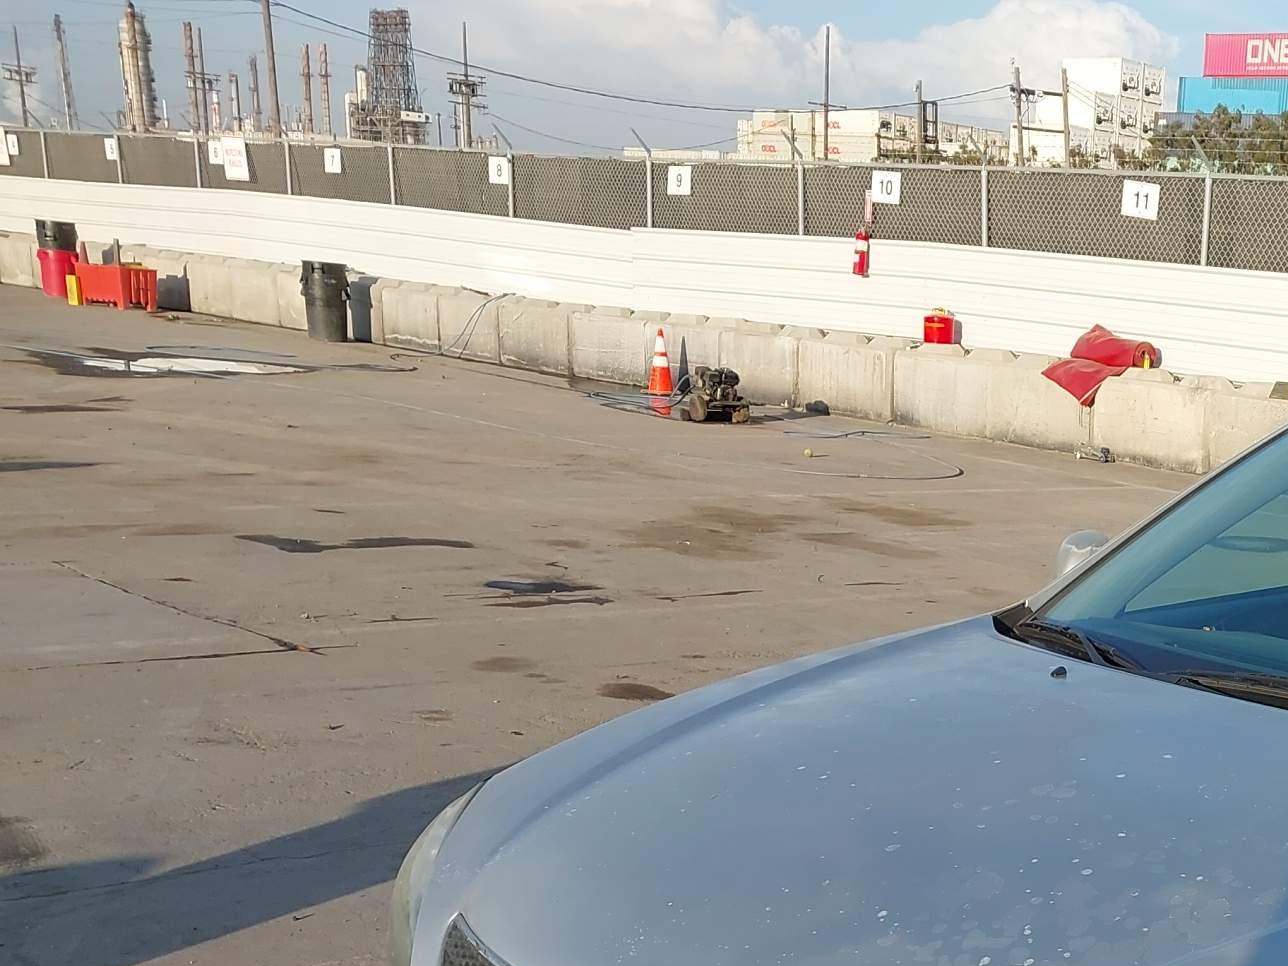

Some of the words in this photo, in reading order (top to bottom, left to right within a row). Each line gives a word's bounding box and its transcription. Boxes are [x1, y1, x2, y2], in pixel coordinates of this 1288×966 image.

[826, 121, 841, 129] OCL
[826, 146, 841, 154] OCL
[329, 154, 335, 167] 7
[496, 164, 502, 177] 8
[675, 173, 683, 188] 9
[879, 180, 893, 196] 10
[1134, 191, 1149, 209] 11
